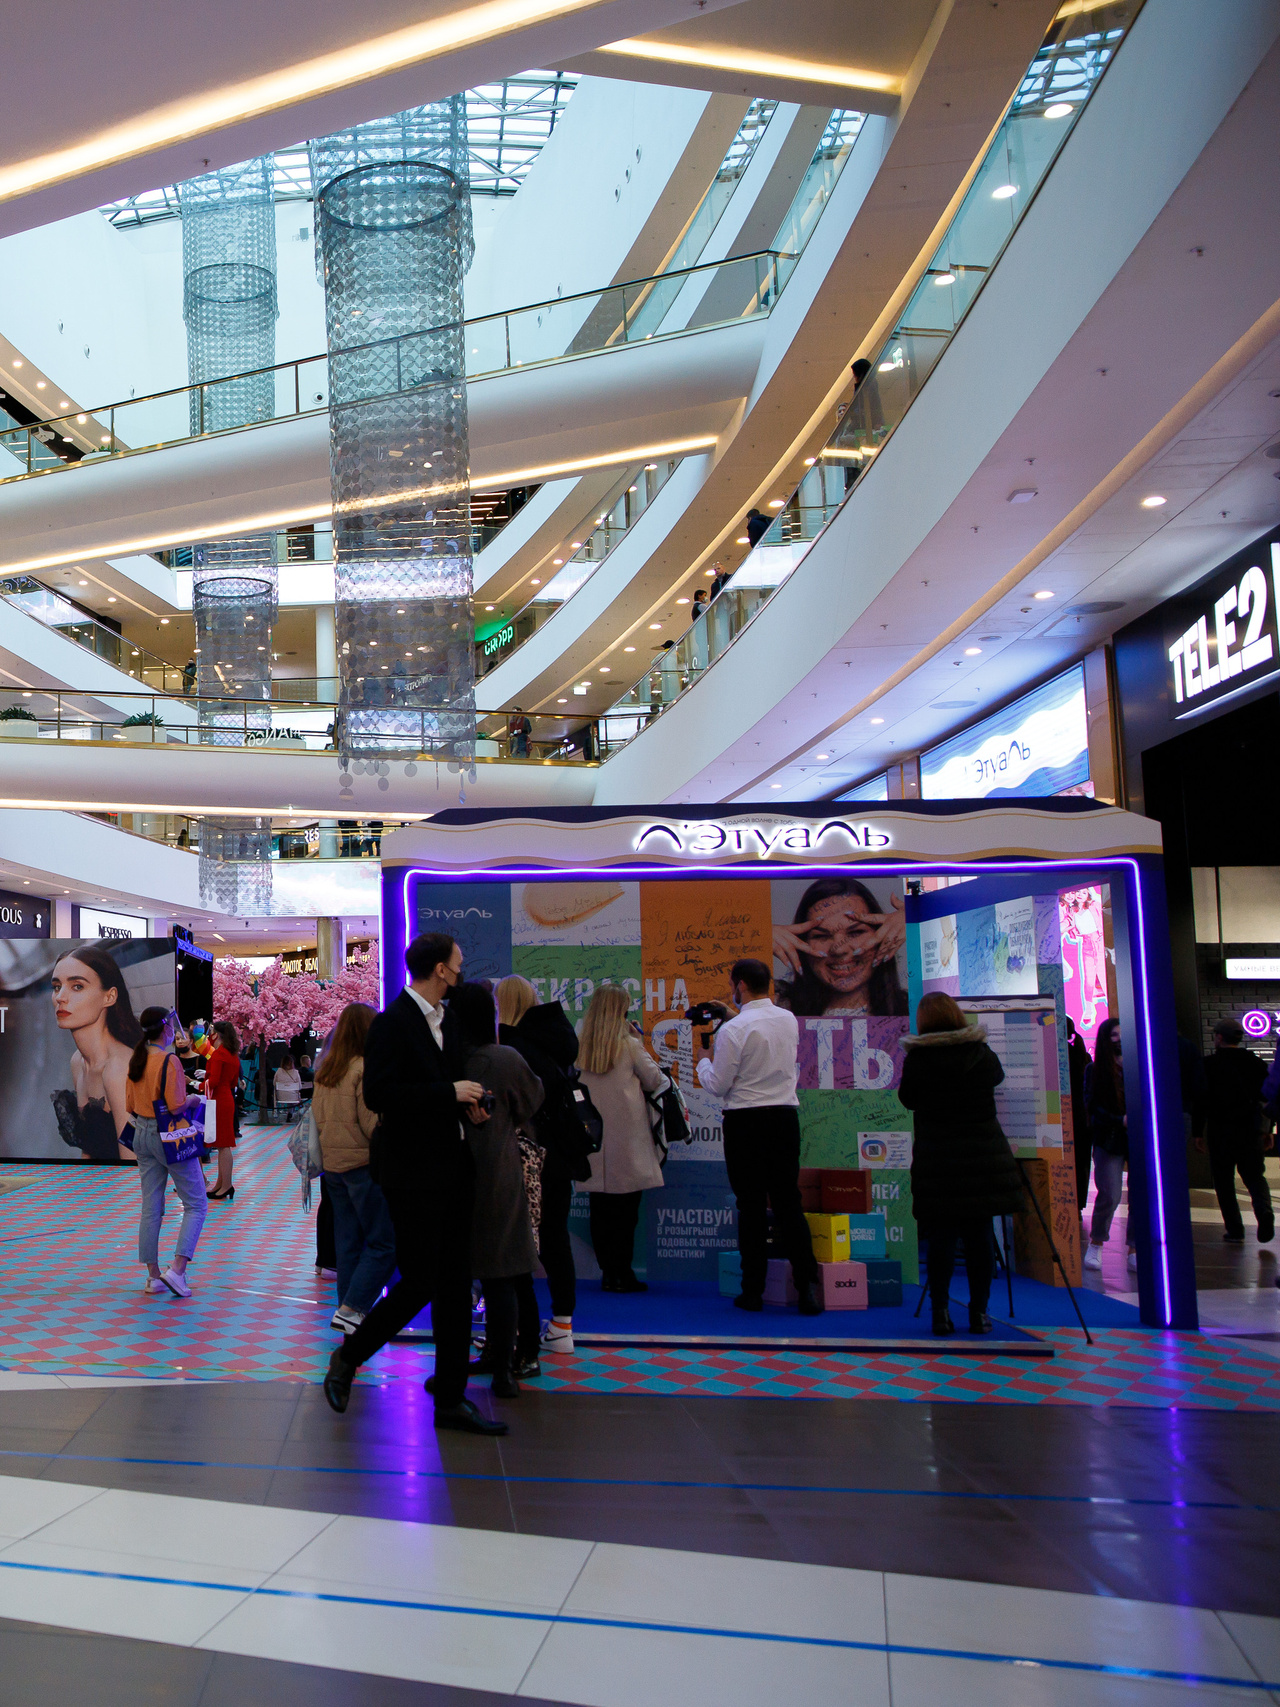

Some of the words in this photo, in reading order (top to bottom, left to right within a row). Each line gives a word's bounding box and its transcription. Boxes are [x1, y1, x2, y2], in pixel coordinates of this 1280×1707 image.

[484, 625, 514, 656] CROPP
[1169, 566, 1274, 704] TELE2
[97, 922, 132, 939] NESPRESSO
[657, 1206, 733, 1226] УЧАСТВУЙ
[657, 1226, 663, 1235] В
[664, 1226, 718, 1236] РОЗЫГРЫШЕ
[657, 1237, 697, 1248] ГОДОВЫХ
[699, 1238, 738, 1248] ЗАПАСОВ
[657, 1248, 706, 1259] КОСМЕТИКИ
[834, 1278, 857, 1289] soda
